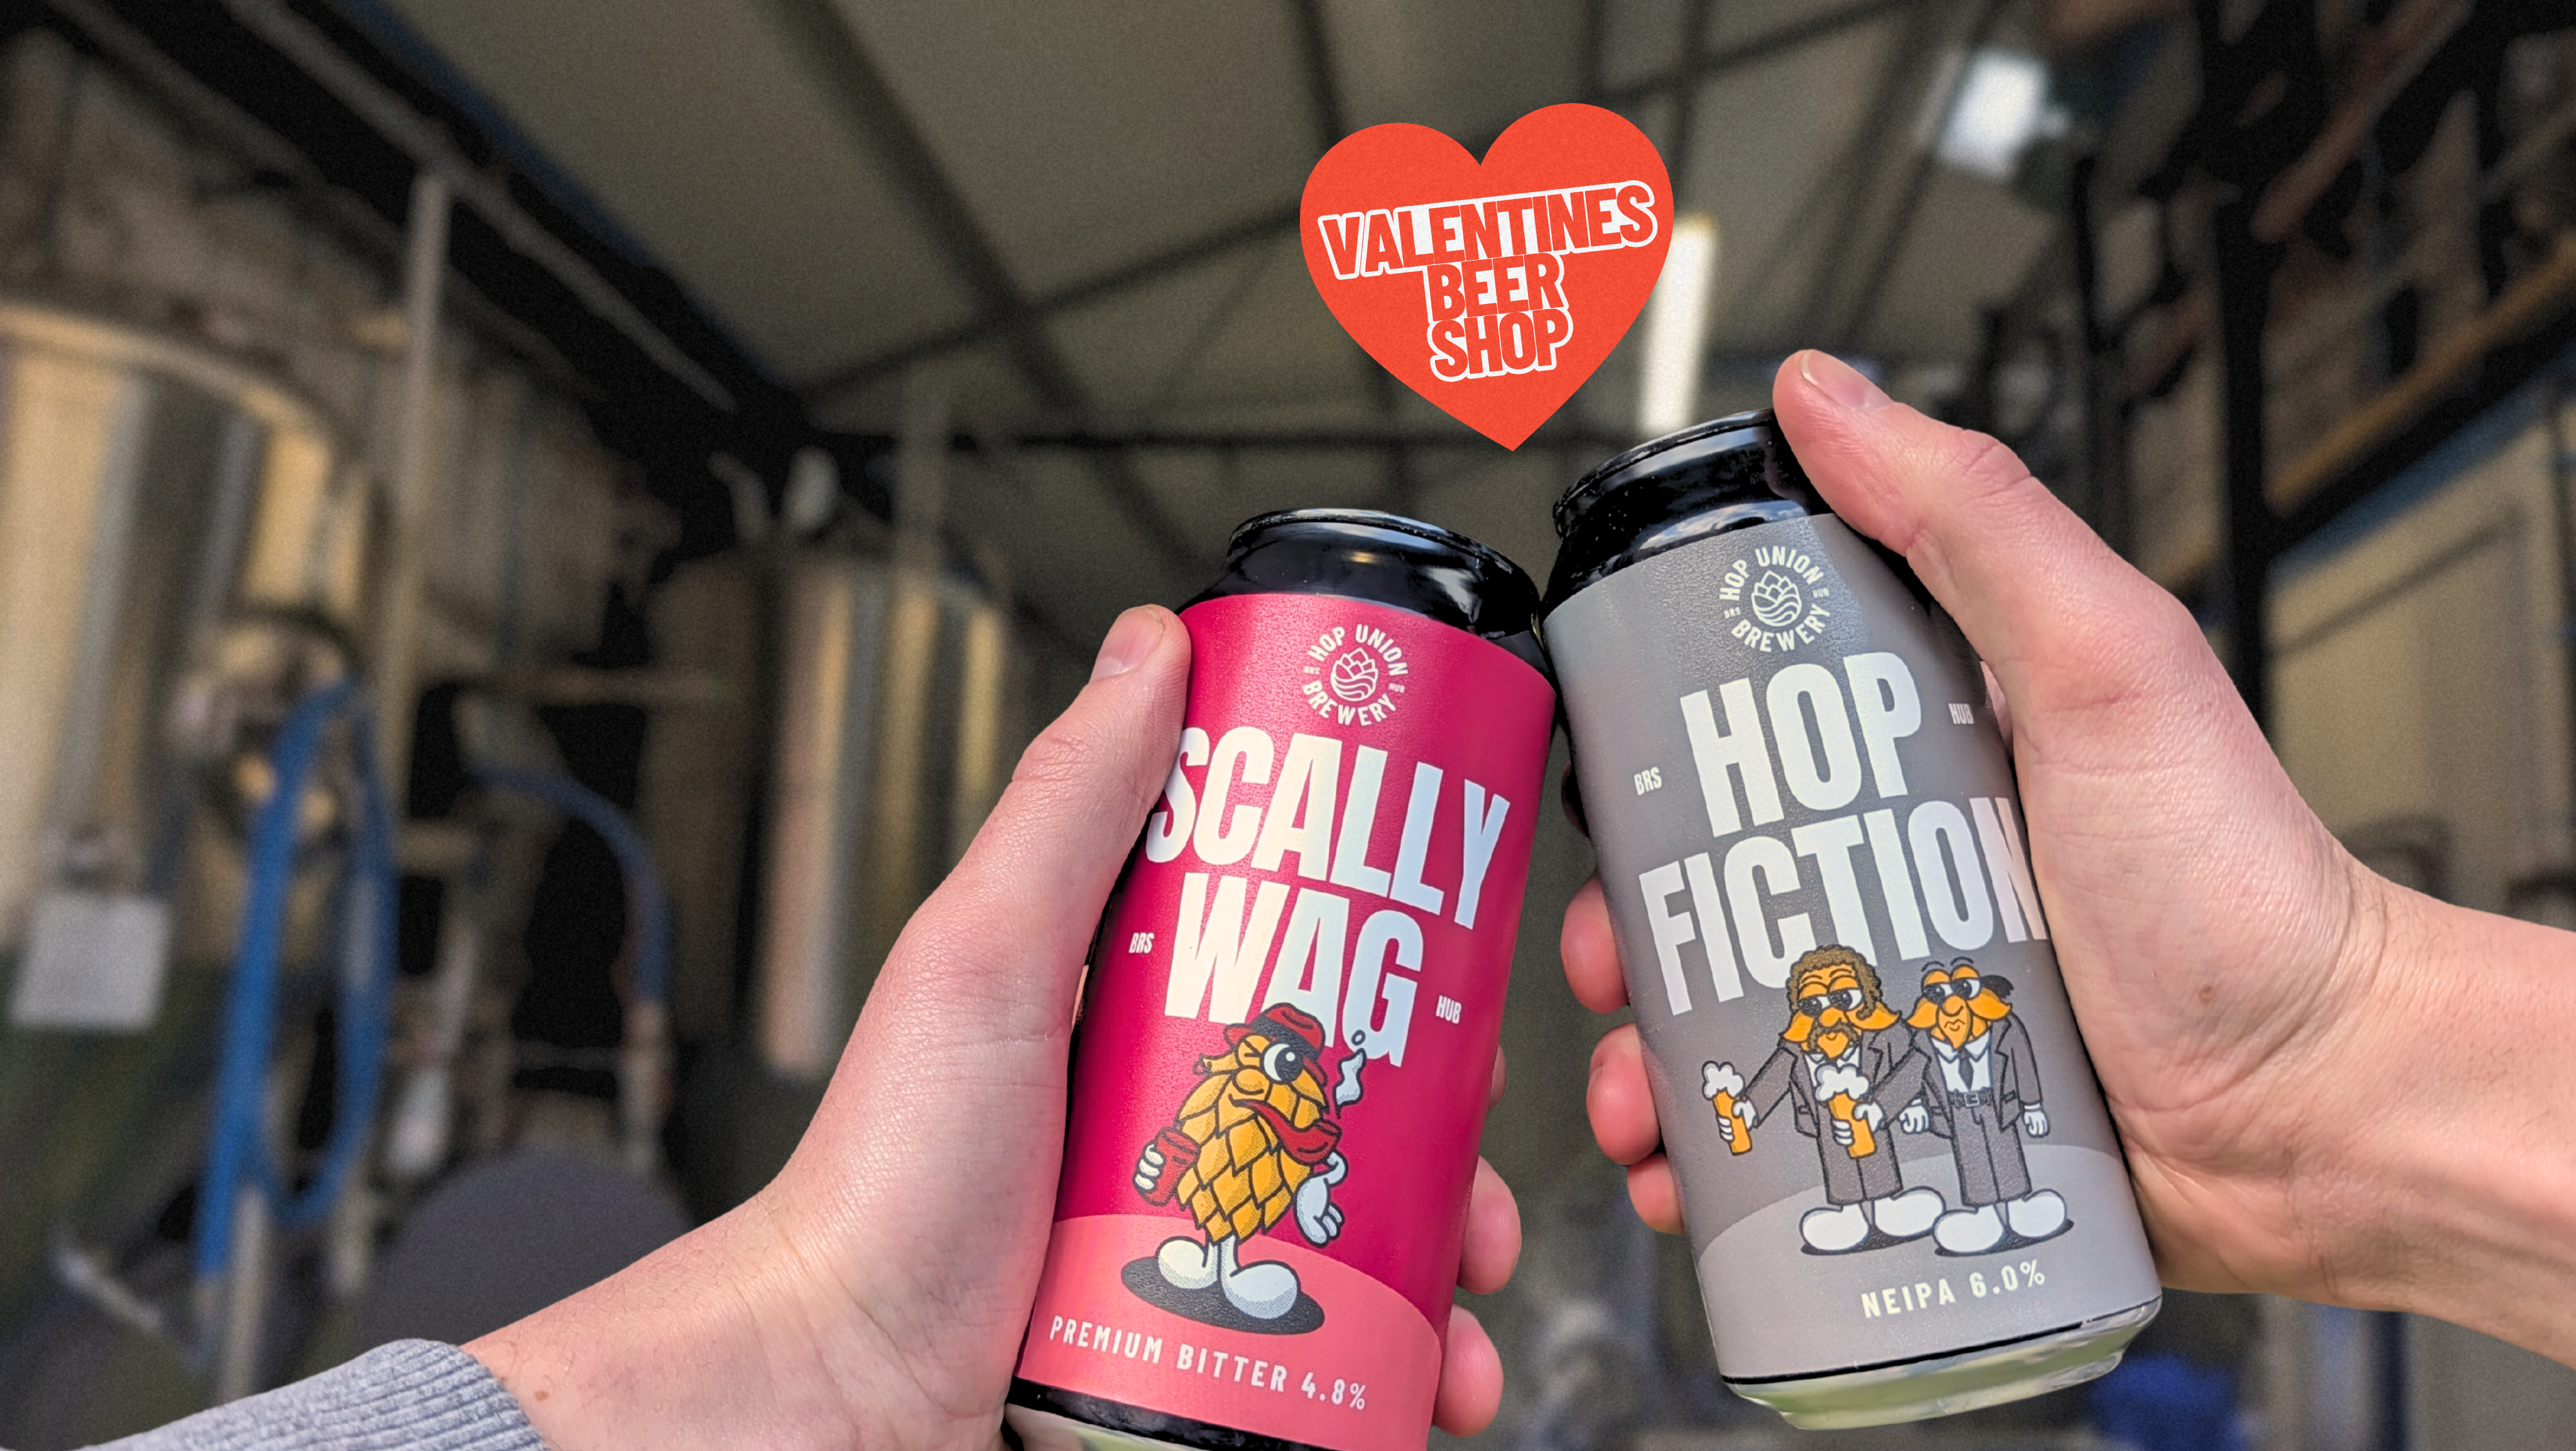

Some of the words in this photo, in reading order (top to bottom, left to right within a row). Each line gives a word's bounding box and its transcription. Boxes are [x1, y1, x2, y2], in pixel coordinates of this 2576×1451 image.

[1719, 560, 1750, 601] HOP
[1755, 546, 1823, 585] UNION
[1307, 627, 1345, 661] HOP
[1355, 624, 1408, 676] UNION
[1731, 603, 1830, 652] BREWERY
[1302, 680, 1396, 726] BREWERY
[1948, 703, 1974, 724] HUB
[1680, 652, 1921, 837] HOP
[1634, 766, 1662, 796] BRS
[1145, 726, 1510, 930] SCALLY
[1639, 797, 2048, 1016] FICTION
[1128, 932, 1154, 954] BRS
[1164, 872, 1424, 1067] WAG
[1436, 995, 1462, 1024] HUB
[1861, 1278, 1956, 1318] NEIPA
[1969, 1259, 2045, 1298] 6.0%
[1049, 1315, 1163, 1364] PREMIUM
[1177, 1344, 1287, 1392] BITTER
[1301, 1372, 1367, 1411] 4.8%
